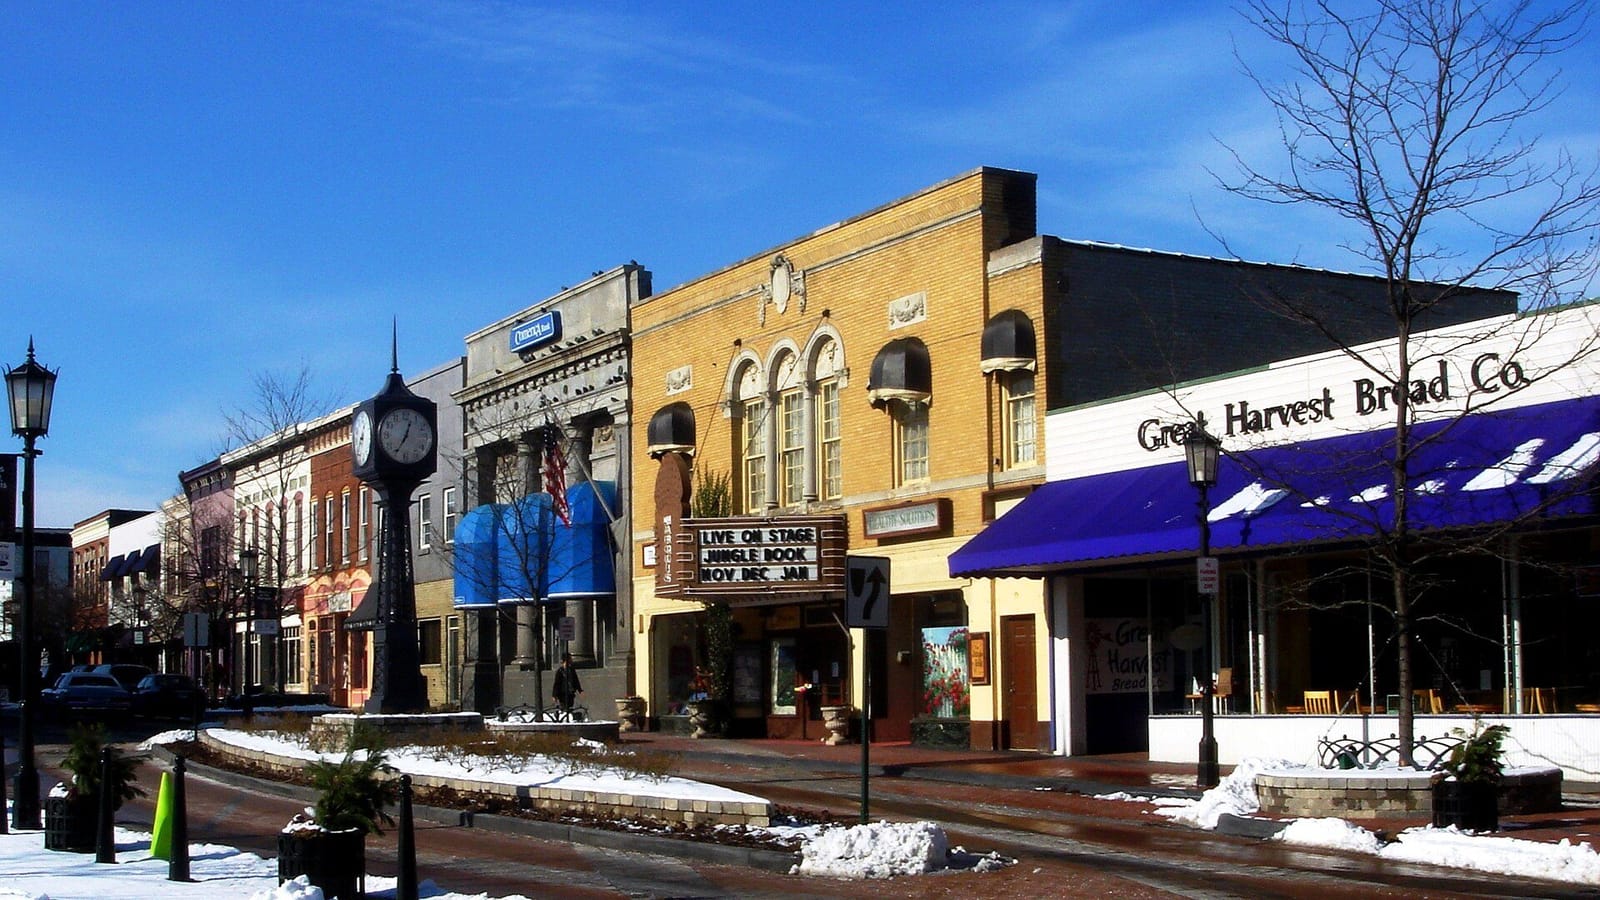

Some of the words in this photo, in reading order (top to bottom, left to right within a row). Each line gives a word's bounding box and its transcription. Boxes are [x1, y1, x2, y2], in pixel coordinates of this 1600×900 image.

[1224, 386, 1335, 437] Harvest
[702, 530, 736, 544] LIVE
[741, 530, 763, 543] ON
[768, 528, 815, 542] STAGE
[703, 548, 759, 563] JUNGLE
[1111, 676, 1146, 691] Bread
